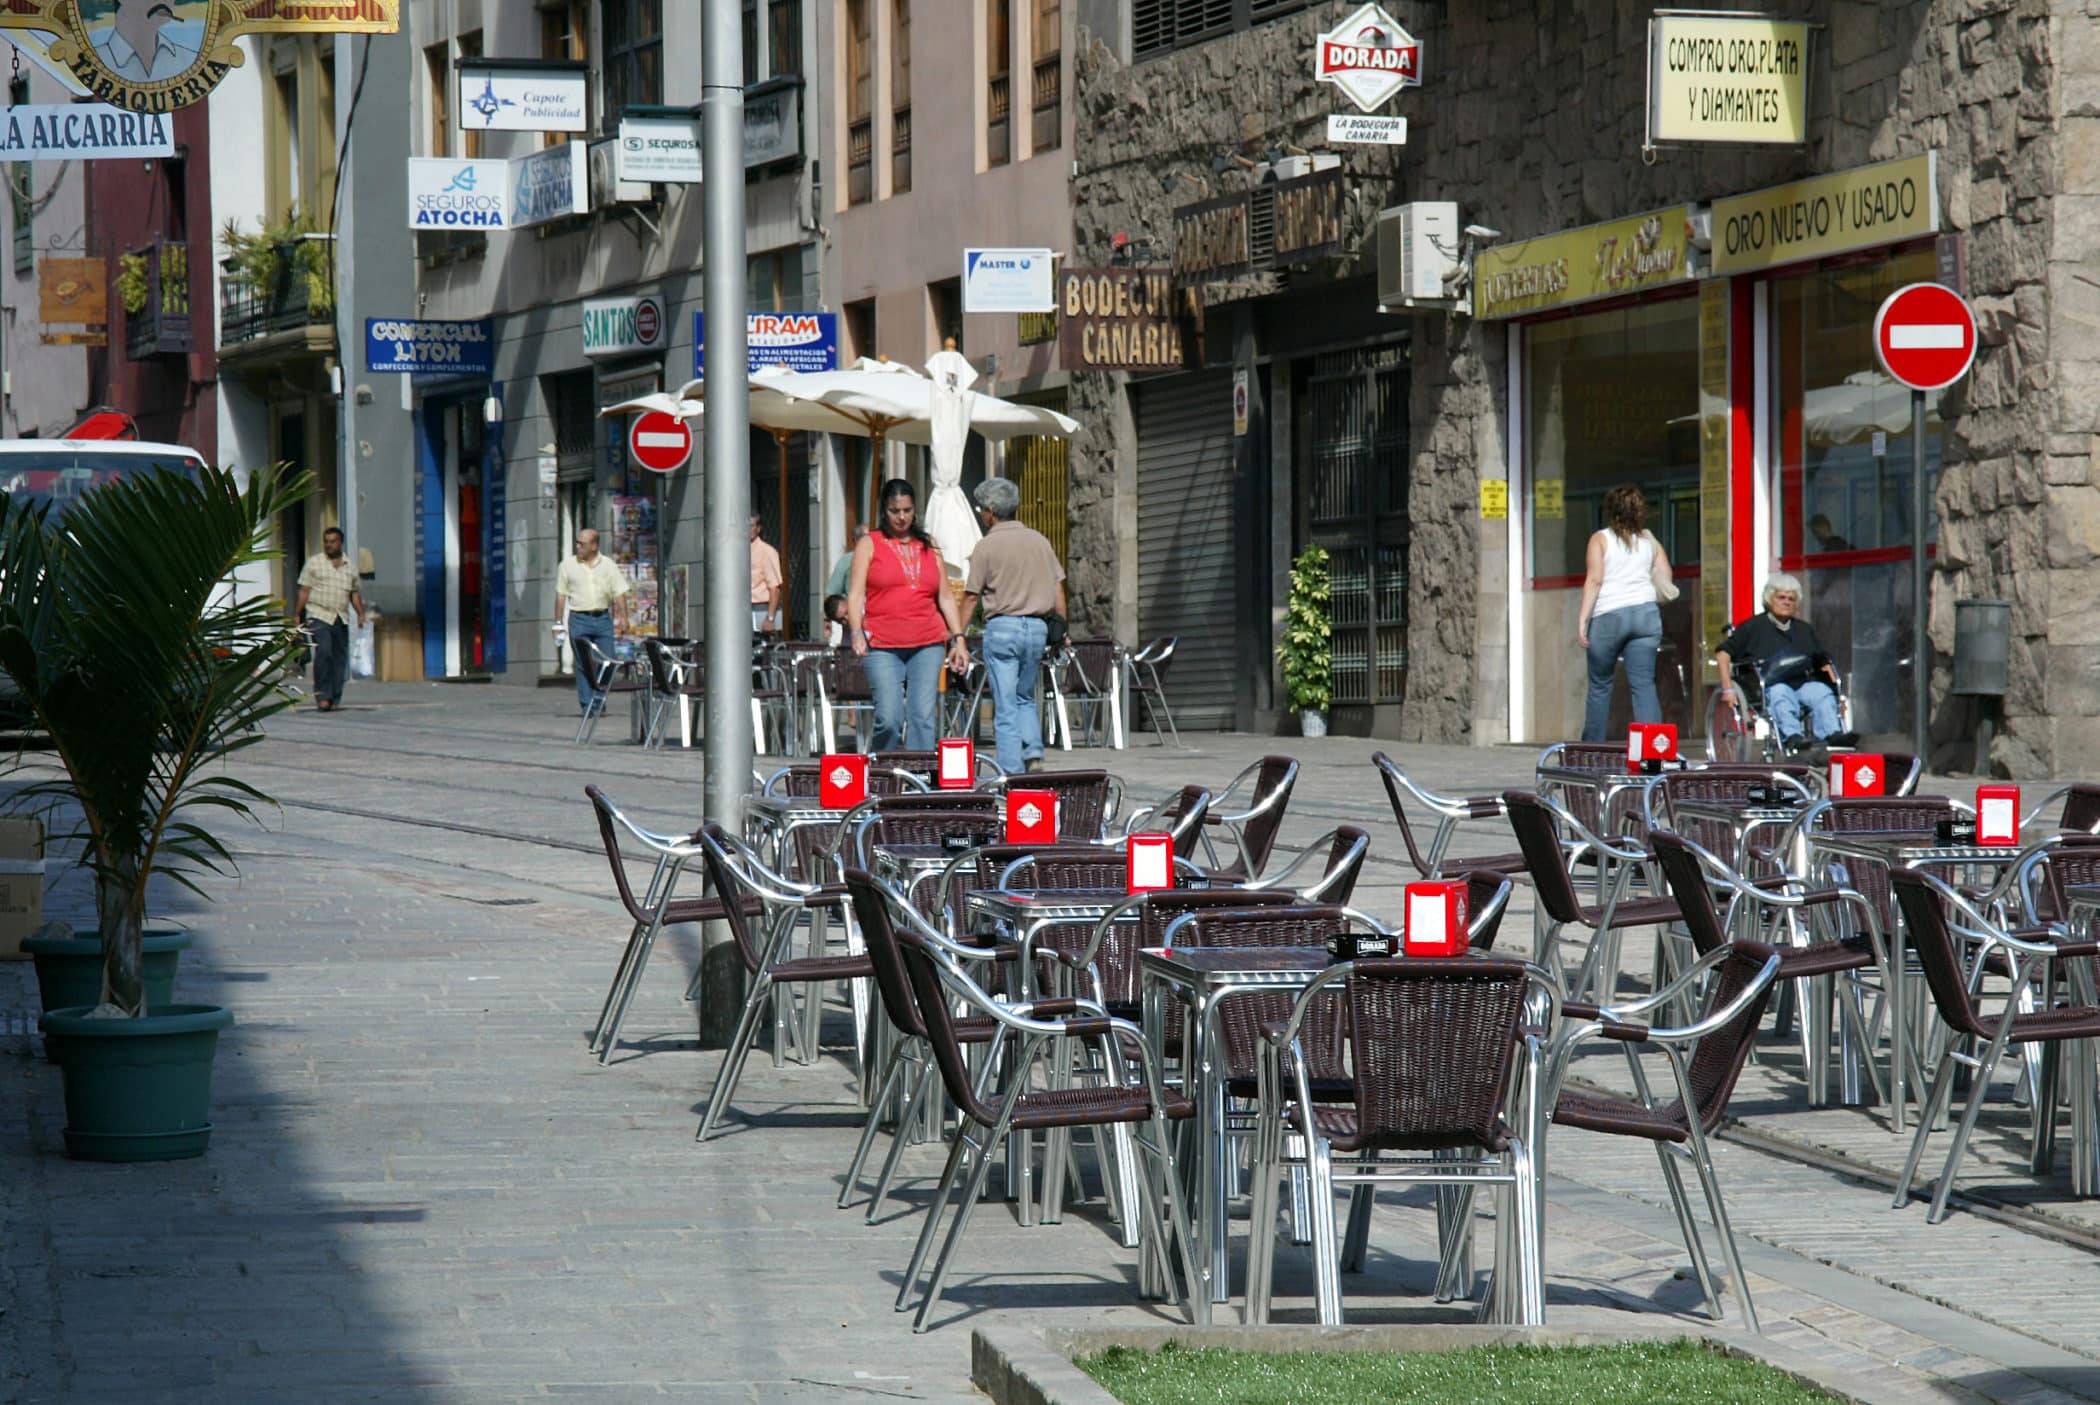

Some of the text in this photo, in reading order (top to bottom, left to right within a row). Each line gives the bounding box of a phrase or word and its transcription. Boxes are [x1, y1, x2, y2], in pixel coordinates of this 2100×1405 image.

[1329, 46, 1412, 70] DORADA
[1669, 37, 1724, 73] COMPRO
[73, 52, 230, 113] TABAQUERIA
[523, 107, 580, 118] Publicidad
[1688, 87, 1779, 123] Y DIAMANTES
[31, 113, 168, 150] ALCARRIA
[1336, 120, 1400, 130] LA BODEGUITA
[1345, 131, 1389, 140] CANARIA
[416, 195, 500, 210] SEGUROS
[532, 179, 573, 217] ATOCHA
[416, 211, 503, 225] ATOCHA
[1726, 177, 1916, 255] ORO NUEVO Y USADO
[980, 261, 1016, 269] MASTER
[372, 322, 486, 341] COMERCIAL
[584, 307, 635, 347] SANTOS
[1082, 321, 1184, 365] CANARIA
[372, 362, 419, 371] CONFECCION
